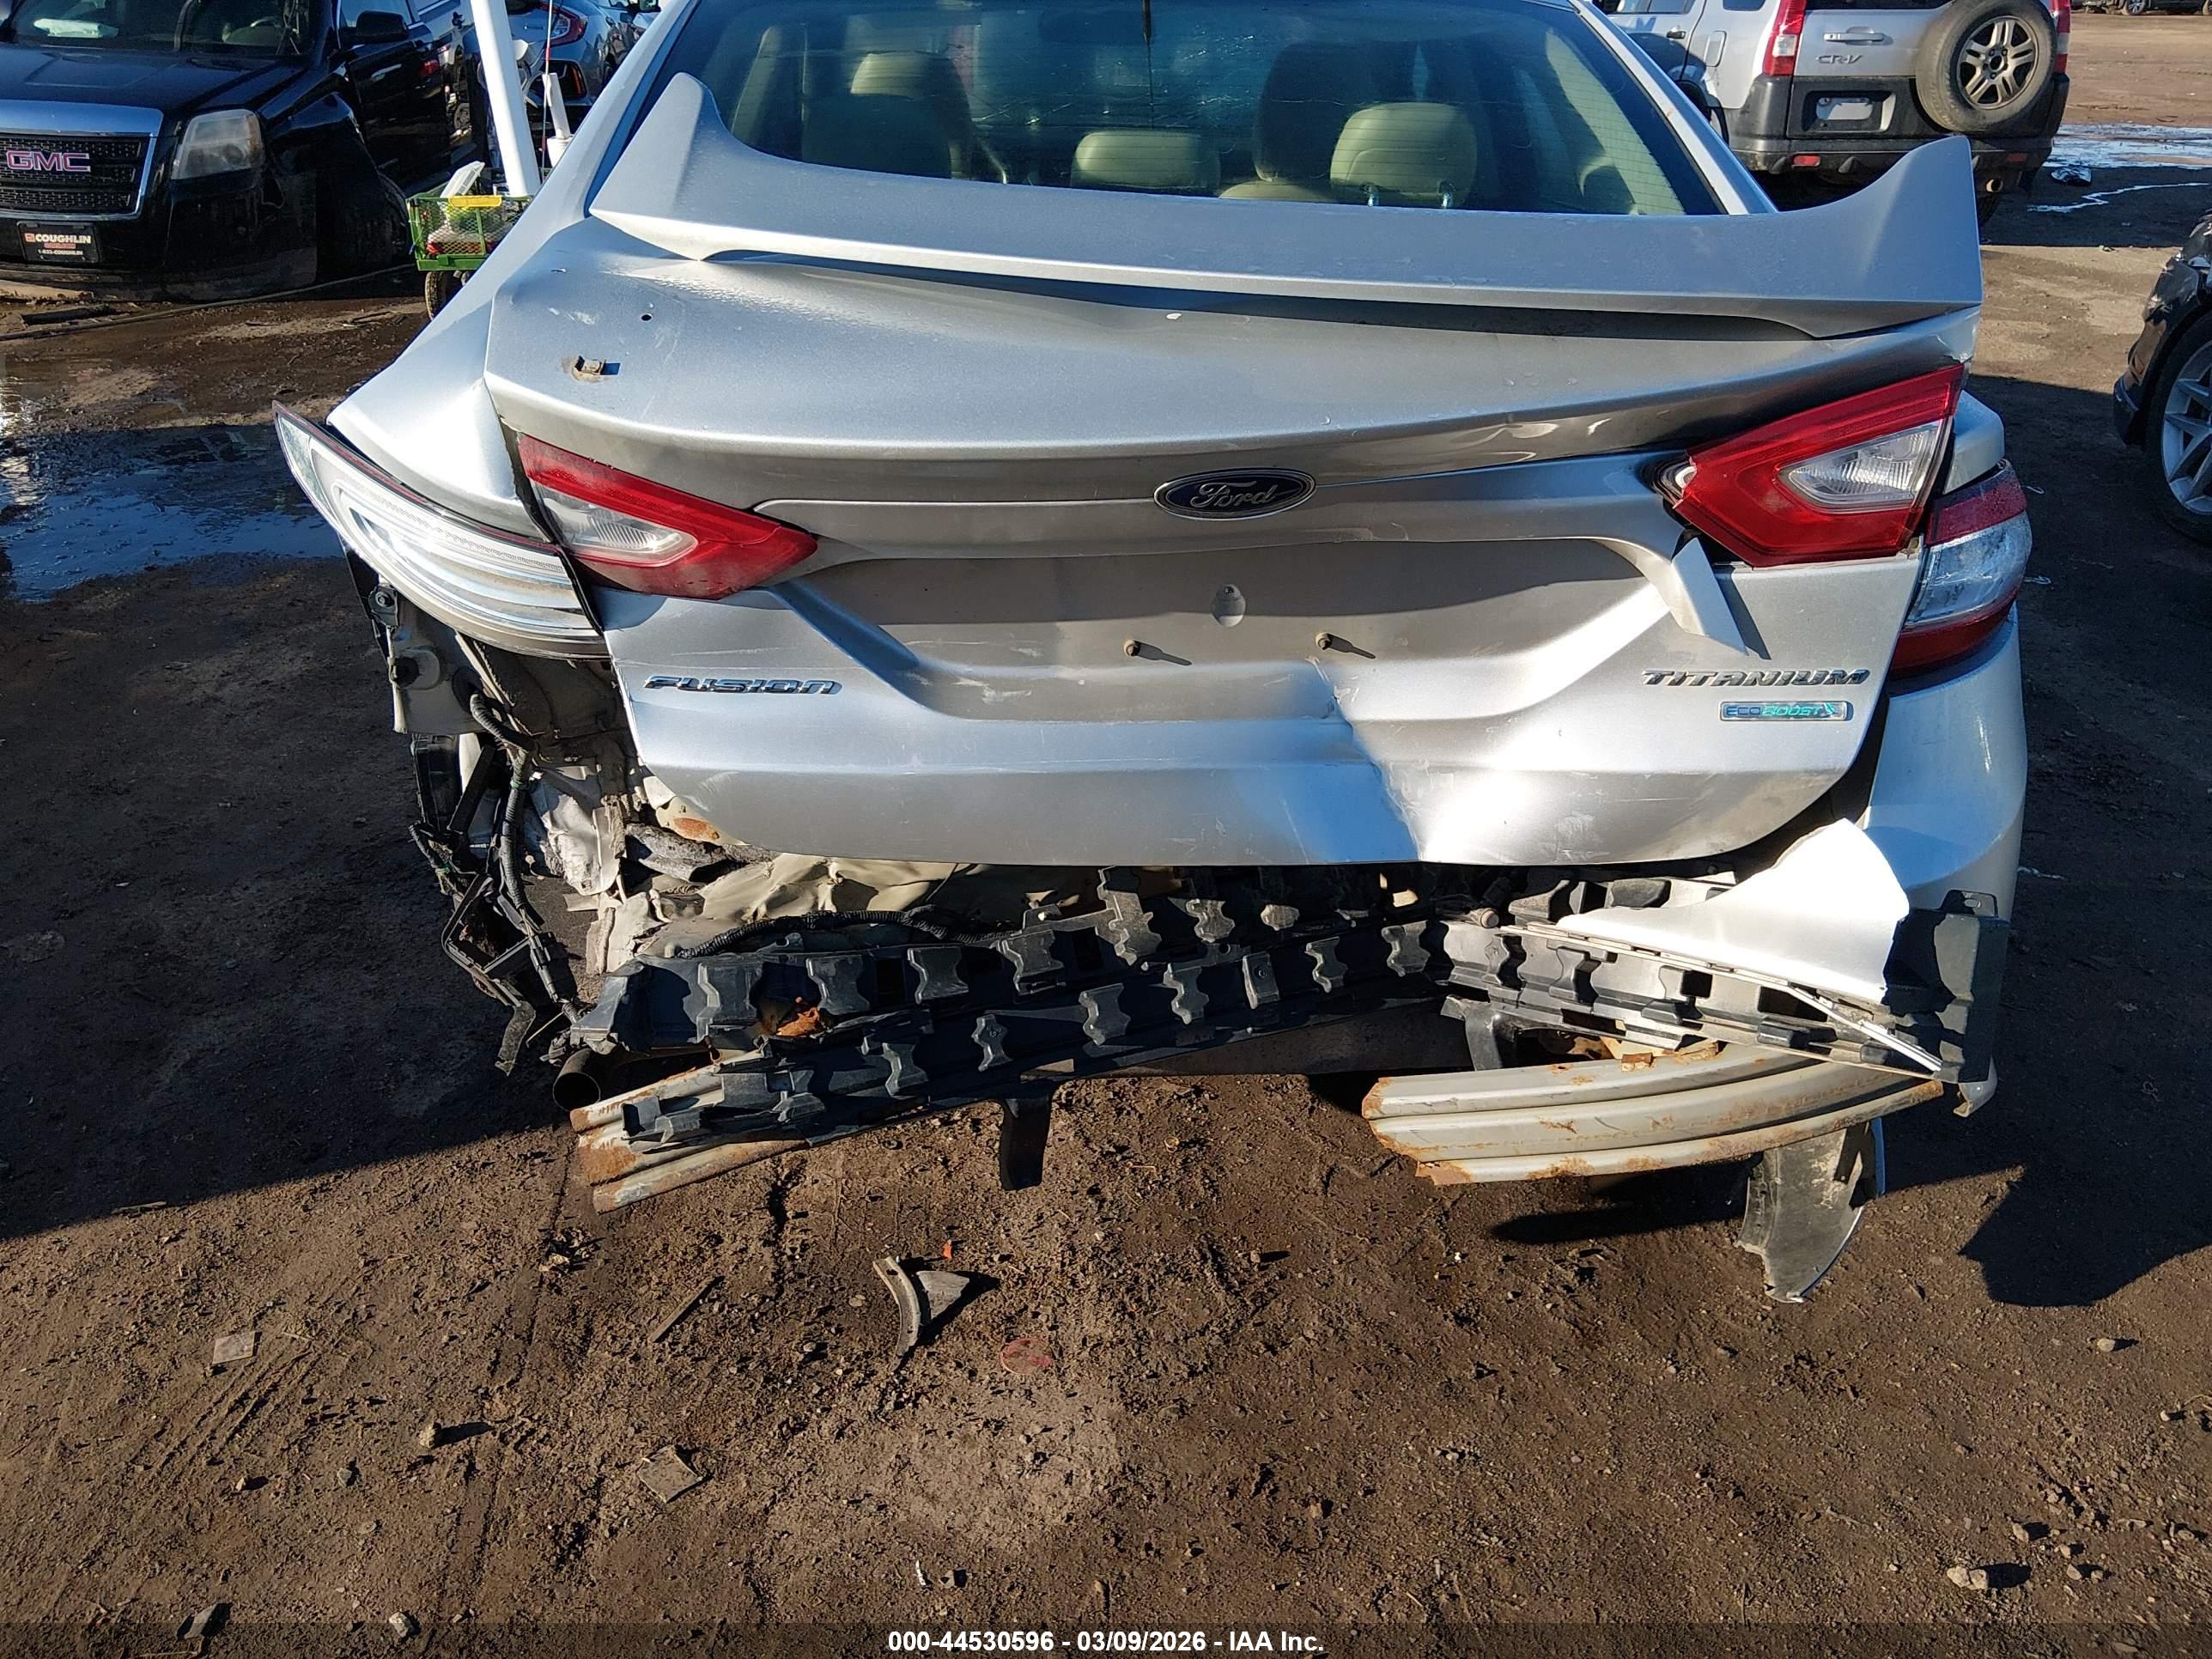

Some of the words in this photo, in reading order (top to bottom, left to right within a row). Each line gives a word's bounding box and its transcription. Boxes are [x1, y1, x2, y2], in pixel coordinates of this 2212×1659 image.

[1816, 55, 1863, 64] CR-V
[6, 150, 91, 172] GMC
[35, 234, 92, 244] COUGHLIN
[1190, 481, 1279, 508] Ford
[644, 675, 842, 695] FUSION
[1641, 670, 1870, 686] TITANIUM
